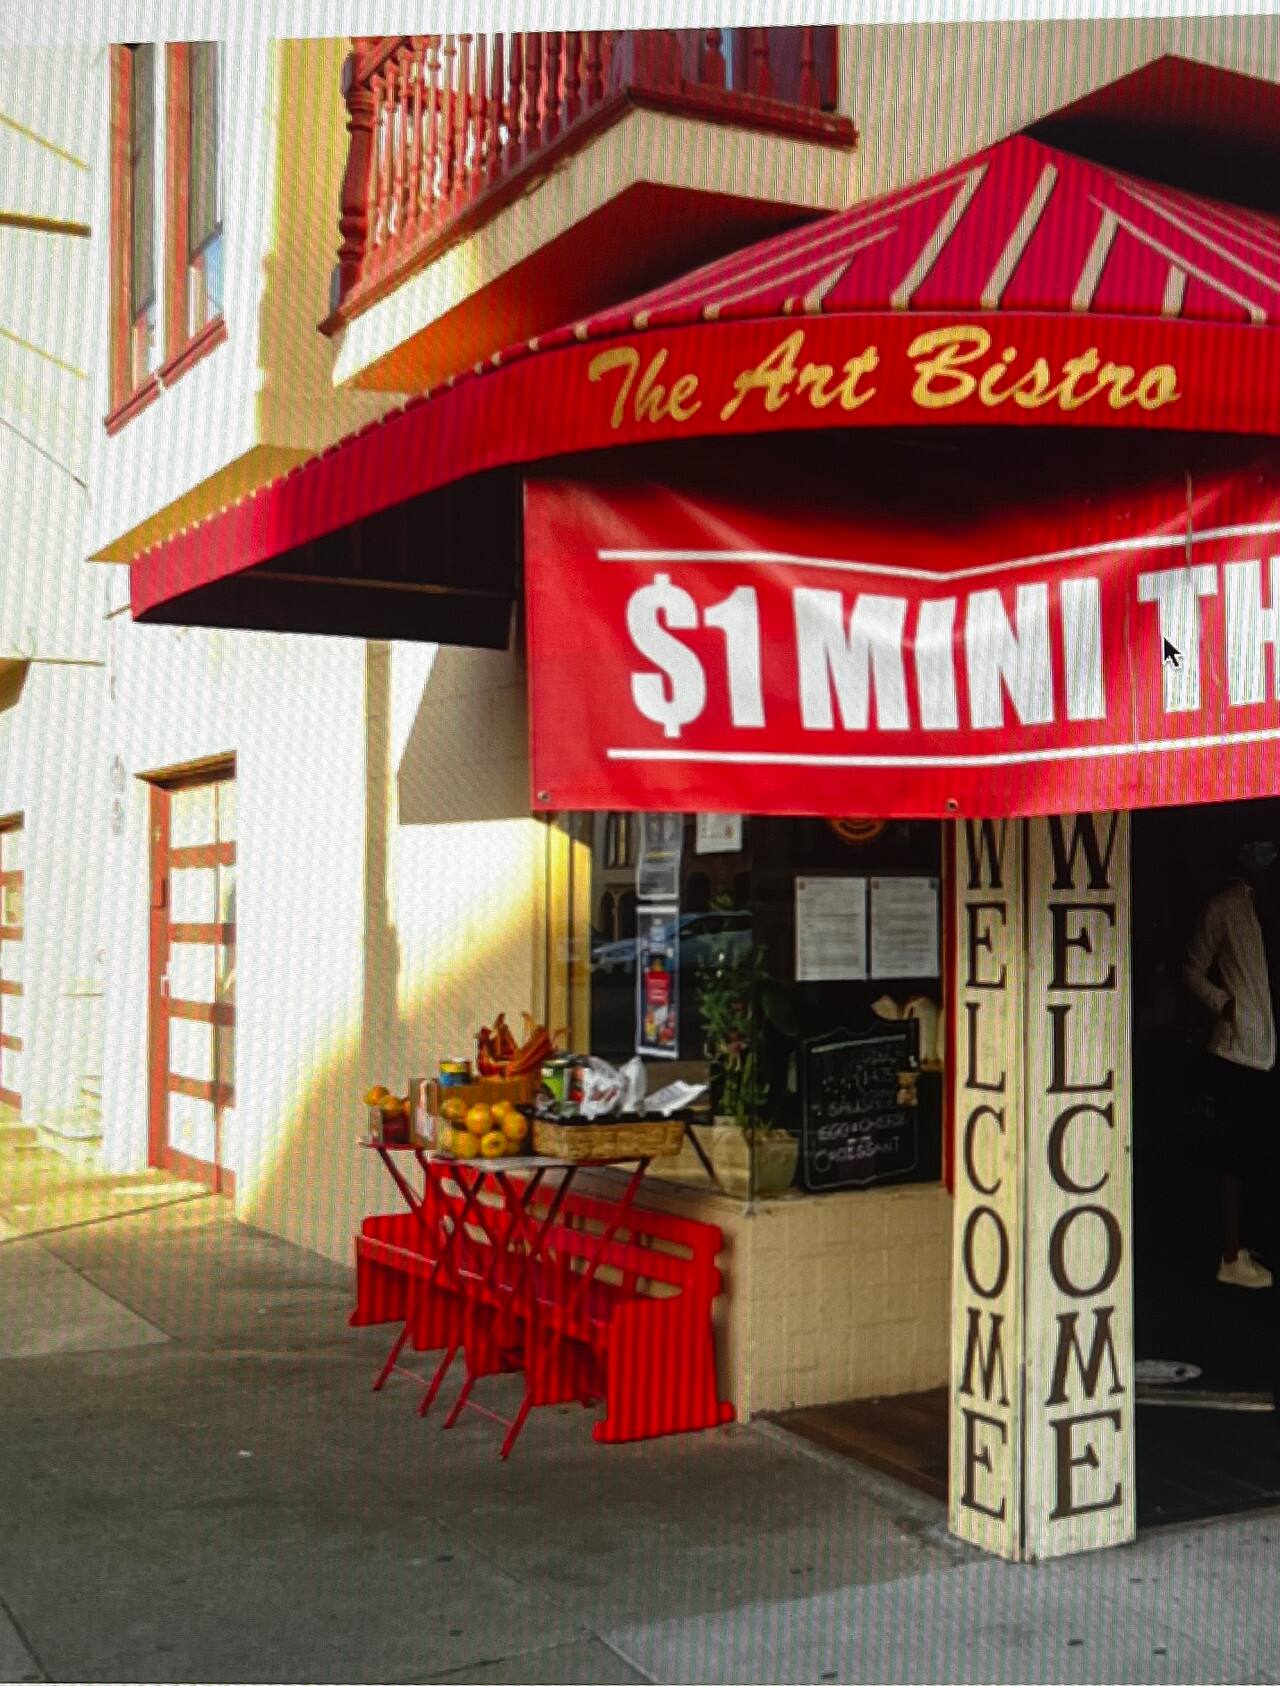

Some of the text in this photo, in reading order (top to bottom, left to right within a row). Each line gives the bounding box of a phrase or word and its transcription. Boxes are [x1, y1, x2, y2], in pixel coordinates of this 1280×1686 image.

[588, 324, 1182, 429] The Art Bistro
[625, 572, 767, 738] $1
[792, 576, 1108, 732] MINI
[960, 818, 1011, 1521] WELCOME
[1044, 813, 1126, 1521] WELCOME
